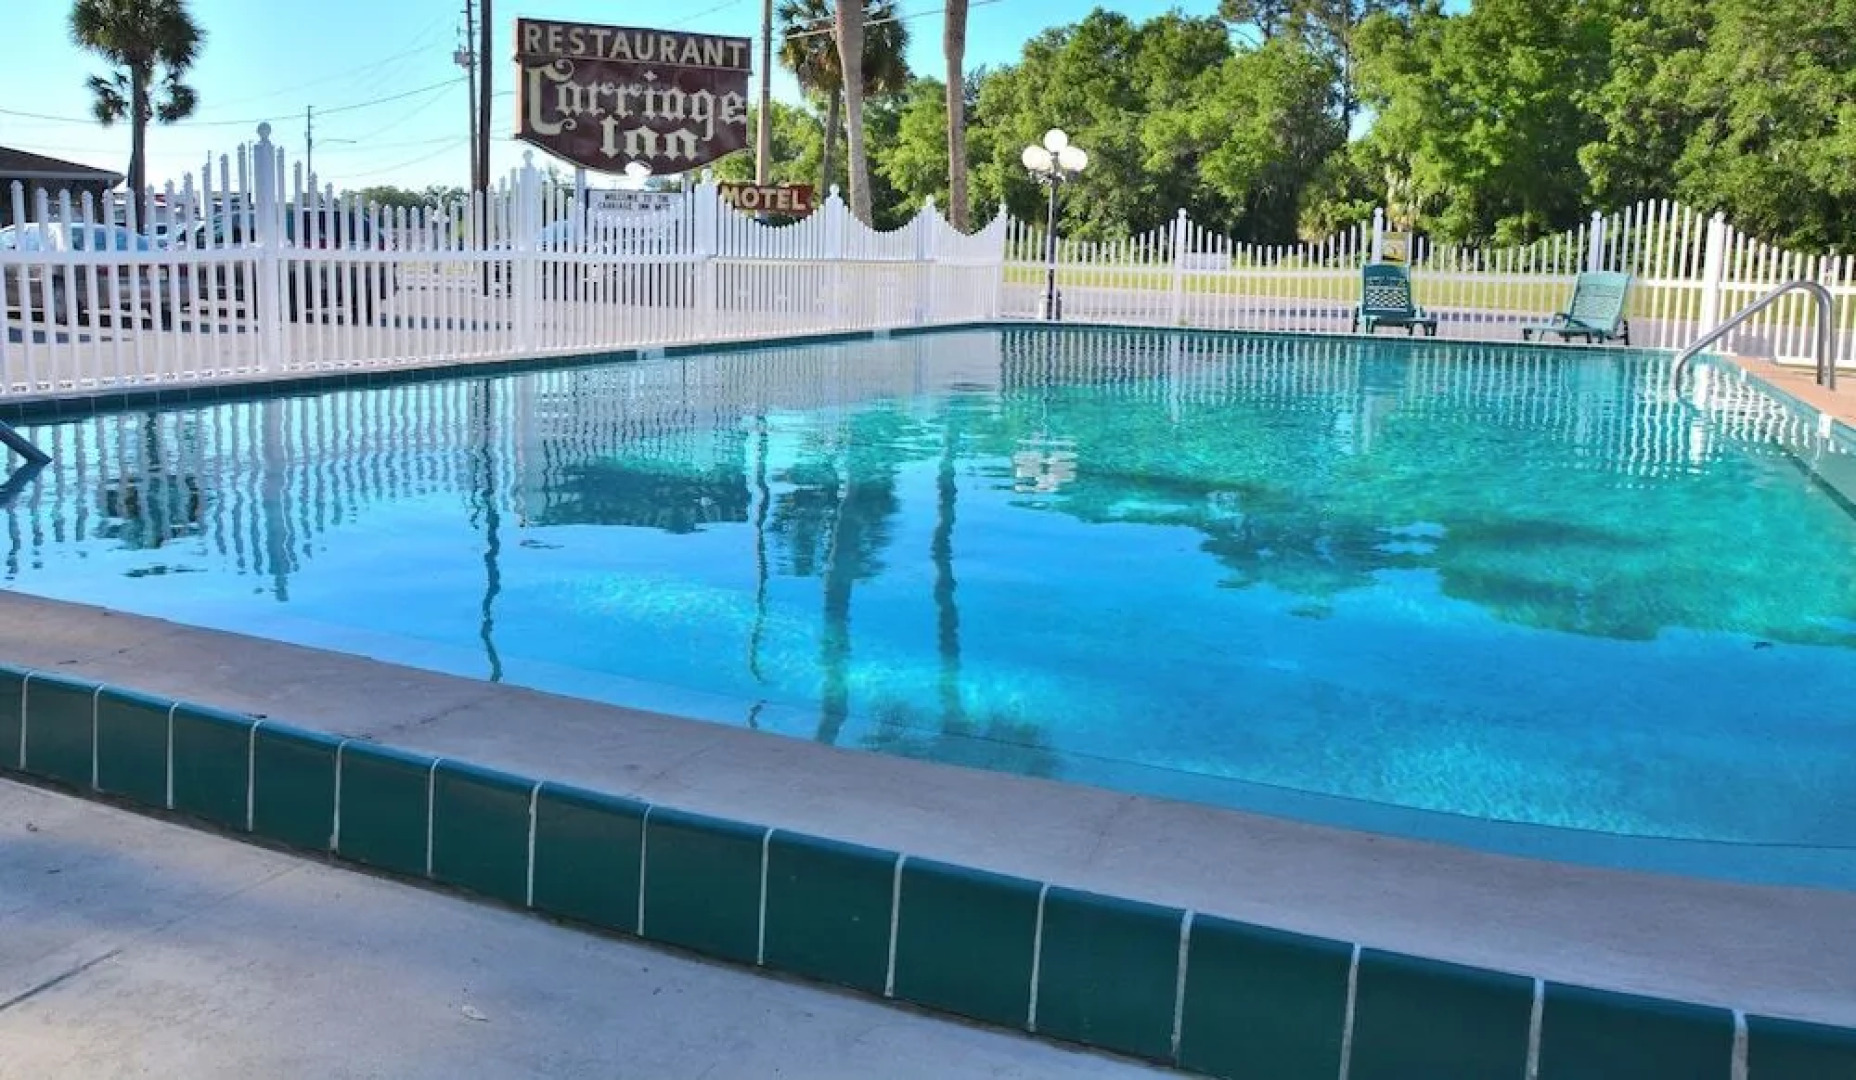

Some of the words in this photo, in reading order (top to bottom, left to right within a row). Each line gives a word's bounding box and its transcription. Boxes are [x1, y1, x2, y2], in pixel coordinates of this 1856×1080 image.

[524, 24, 747, 67] RESTAURANT
[526, 59, 747, 141] Carriage
[600, 115, 699, 160] Inn
[722, 185, 807, 210] MOTEL
